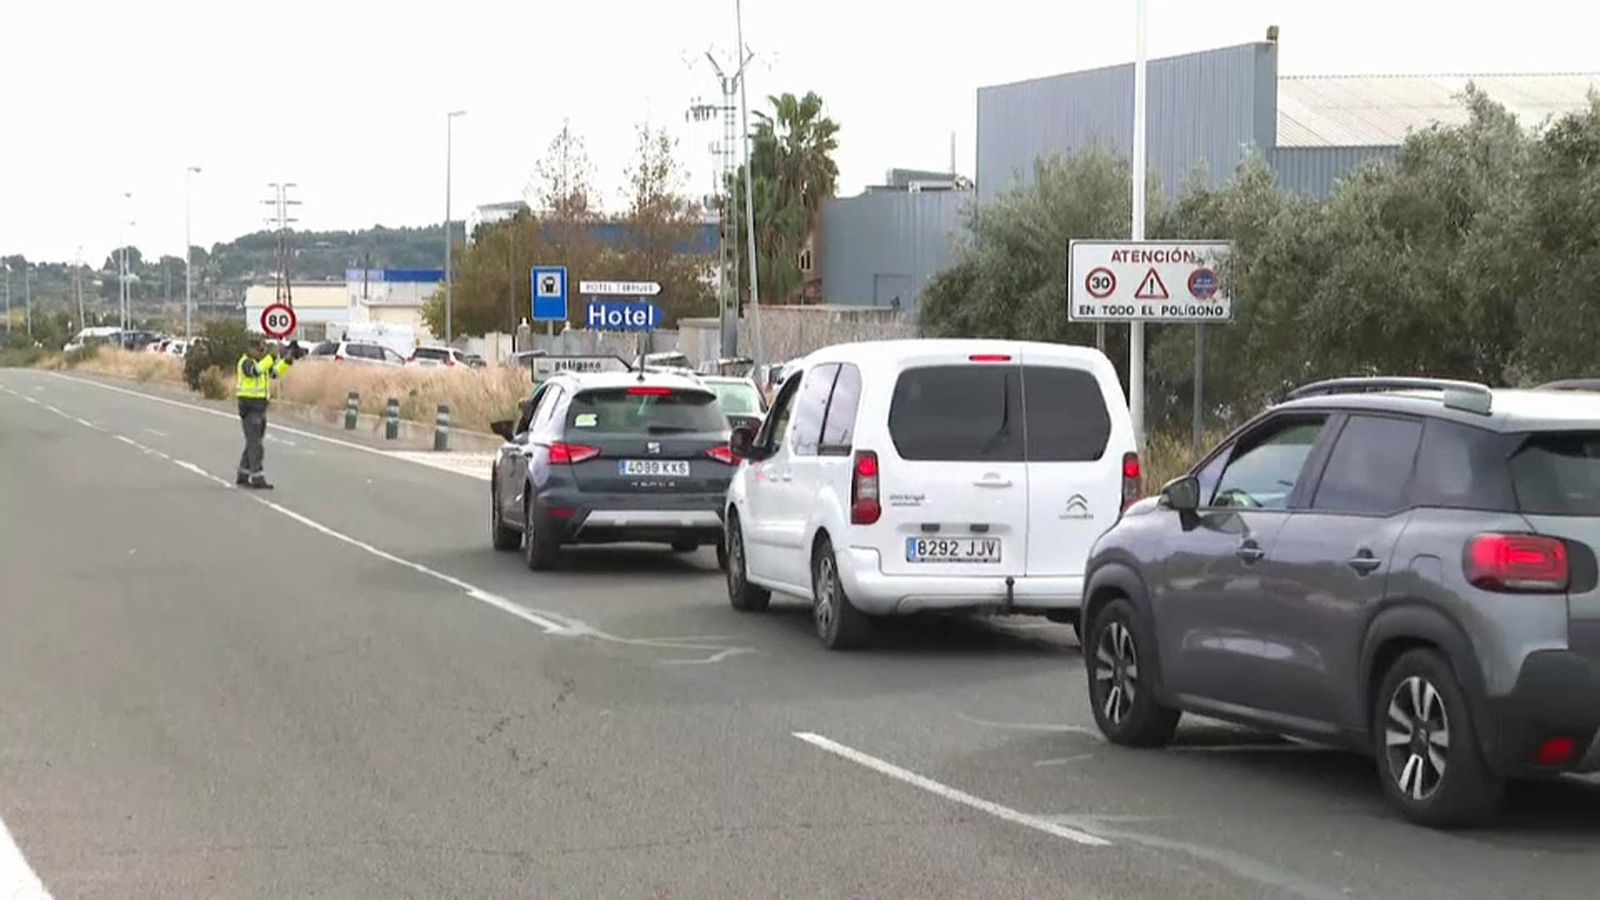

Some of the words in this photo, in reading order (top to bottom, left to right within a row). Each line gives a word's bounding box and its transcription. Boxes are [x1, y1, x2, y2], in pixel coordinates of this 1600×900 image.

[1111, 247, 1195, 263] ATENCIÓN
[1092, 277, 1110, 289] 30
[589, 304, 653, 326] Hotel
[1079, 305, 1095, 316] EN
[1103, 305, 1135, 316] TODO
[1142, 305, 1155, 316] EL
[1161, 304, 1224, 316] POLÍGONO
[268, 315, 289, 327] 80
[917, 540, 958, 556] 8292
[966, 540, 996, 556] JJV
